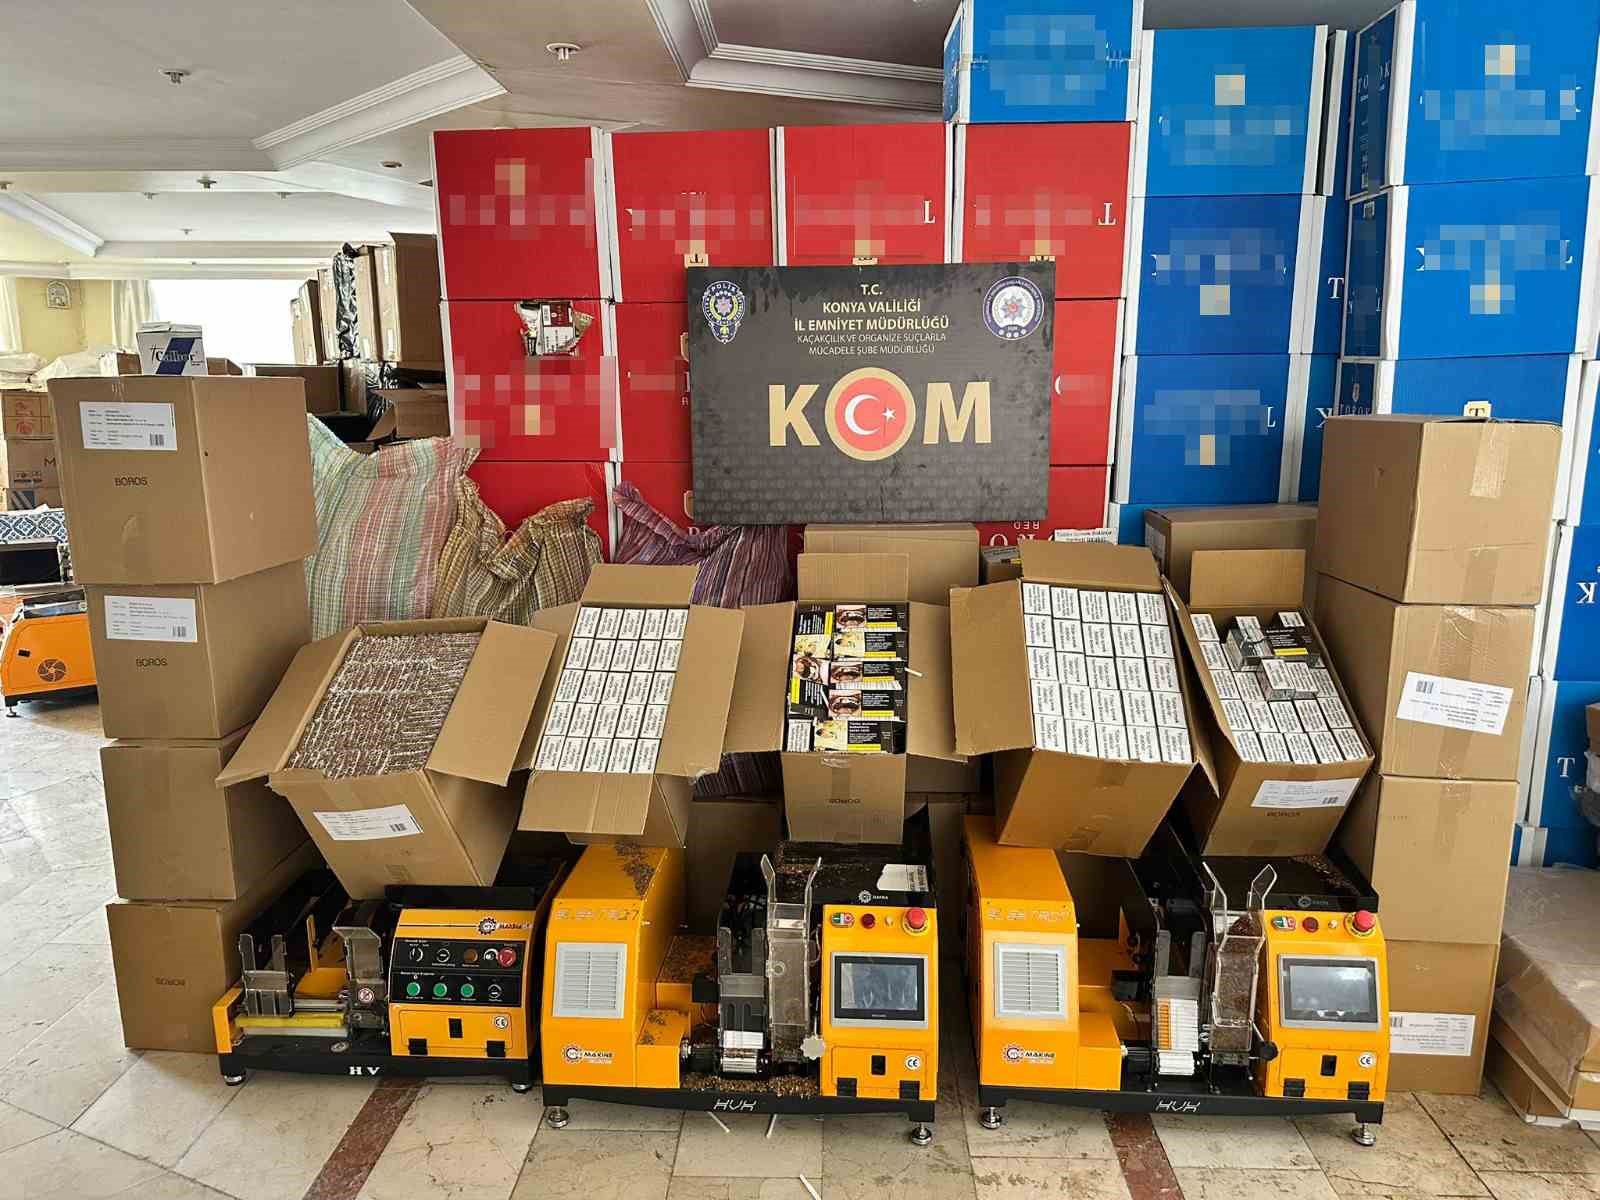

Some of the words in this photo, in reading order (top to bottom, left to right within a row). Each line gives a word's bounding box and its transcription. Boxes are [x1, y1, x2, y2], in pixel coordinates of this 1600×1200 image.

[861, 284, 883, 296] T.C.
[823, 302, 866, 314] KONYA
[869, 298, 921, 313] VALİLİĞİ
[794, 317, 806, 331] İL
[808, 317, 863, 331] EMNİYET
[866, 315, 949, 330] MÜDÜRLÜĞÜ
[903, 332, 946, 343] SUÇLARLA
[809, 346, 855, 355] MÜCADELE
[857, 345, 878, 355] ŞUBE
[880, 343, 935, 354] MÜDÜRLÜĞÜ
[115, 477, 148, 486] BOROS
[136, 657, 168, 667] BOROS
[1360, 1056, 1371, 1065] CE
